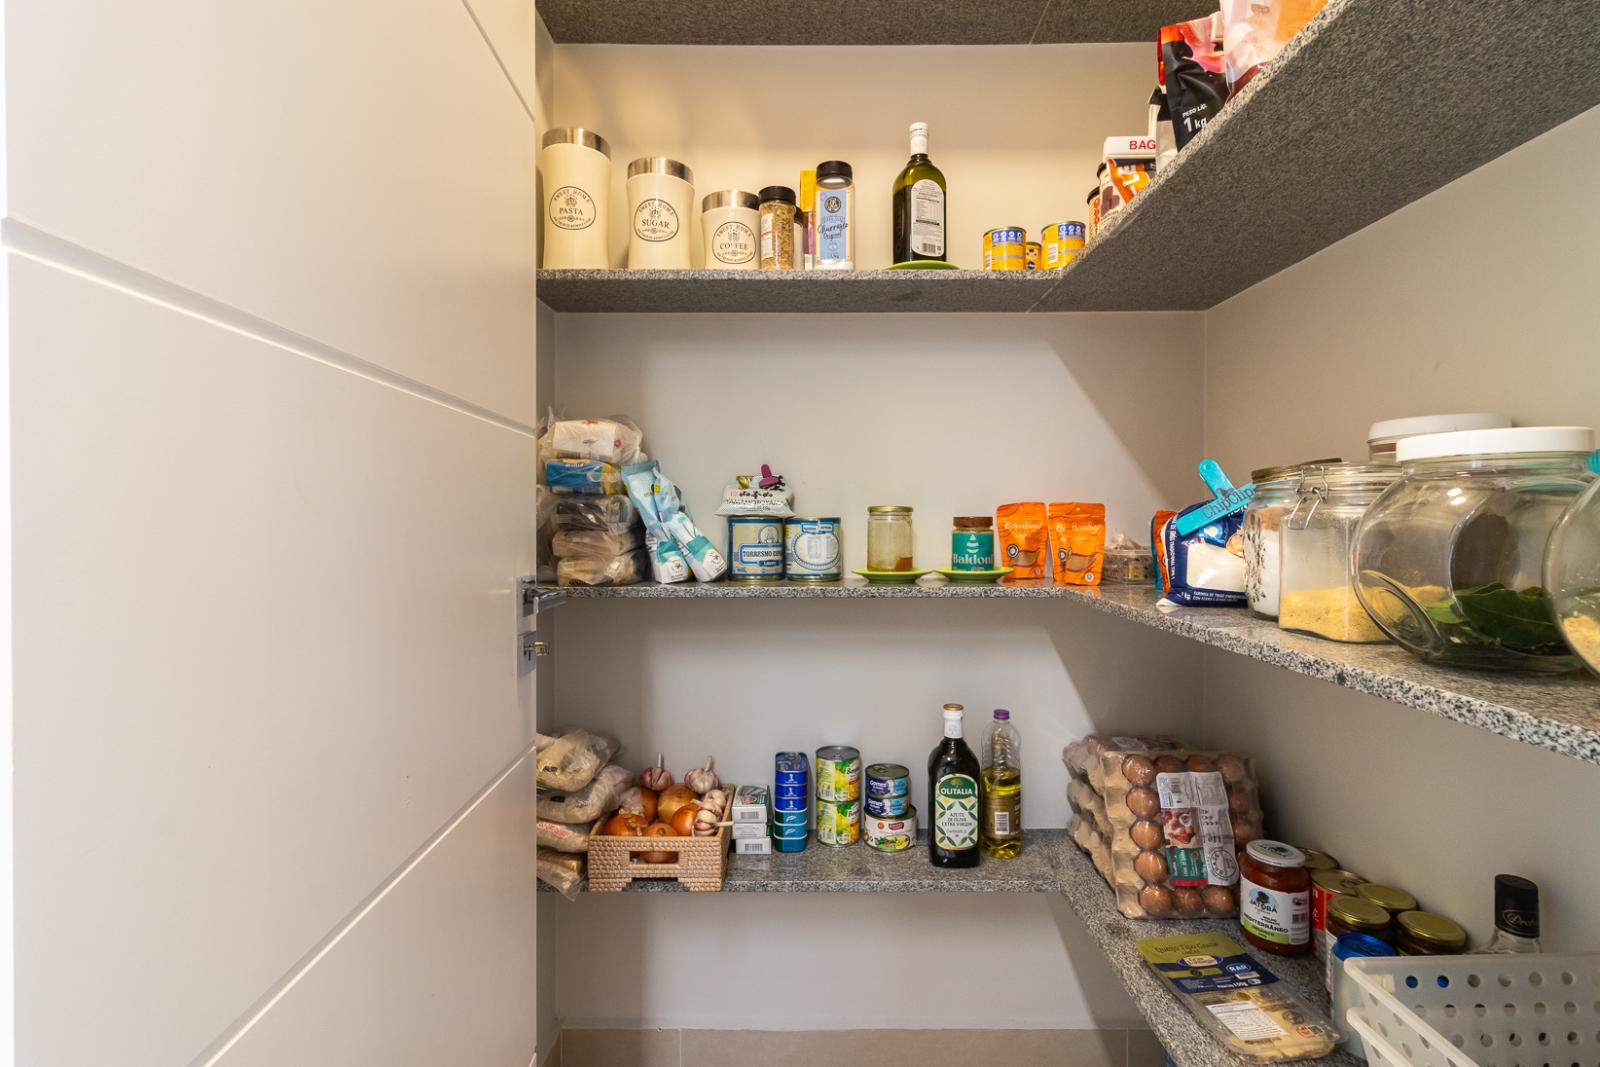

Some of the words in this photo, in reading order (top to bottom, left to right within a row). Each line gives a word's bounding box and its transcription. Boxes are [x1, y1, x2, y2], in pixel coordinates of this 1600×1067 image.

[1183, 117, 1192, 132] 1
[559, 207, 584, 216] PASTA
[641, 218, 670, 229] SUGAR
[719, 242, 748, 251] COFFEE
[941, 787, 973, 795] OLITALIA
